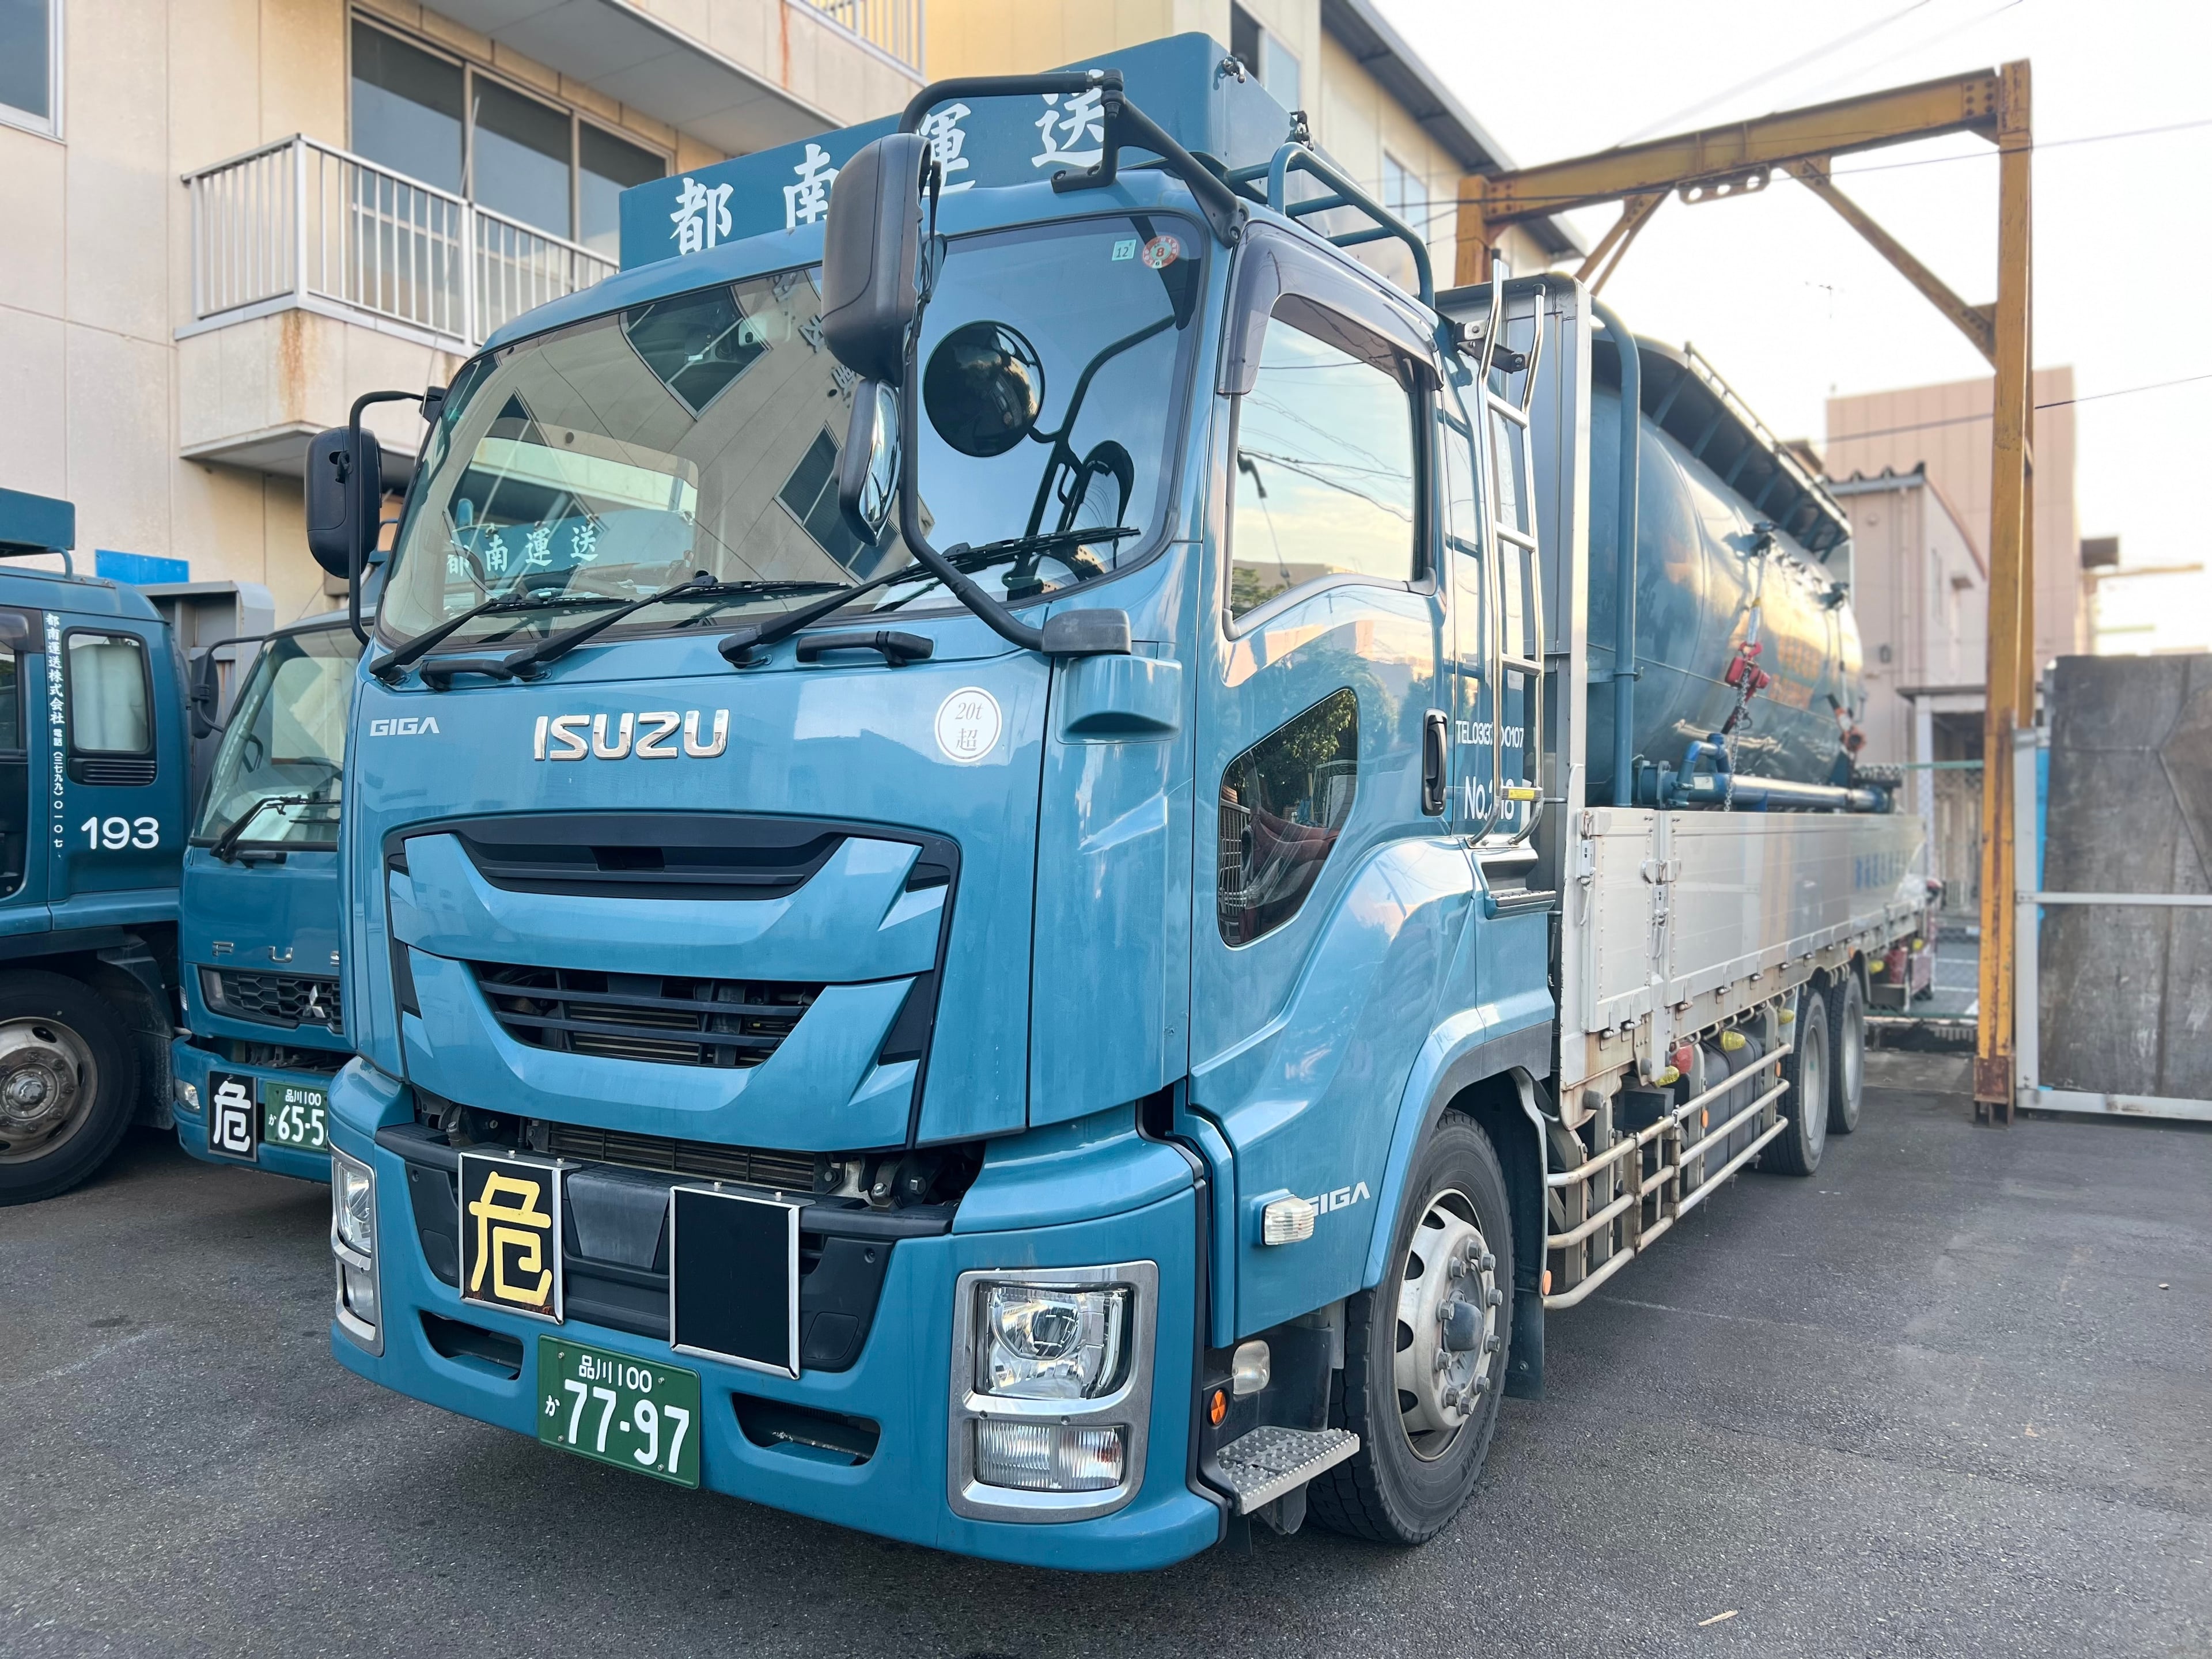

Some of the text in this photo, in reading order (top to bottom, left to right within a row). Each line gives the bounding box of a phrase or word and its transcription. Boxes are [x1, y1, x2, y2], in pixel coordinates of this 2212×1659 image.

[46, 613, 65, 725] 都南運送株式会社
[369, 717, 440, 737] GIGA
[955, 702, 983, 719] 20t
[533, 709, 730, 762] ISUZU
[956, 728, 978, 751] 超
[81, 816, 159, 850] 193
[214, 1081, 251, 1152] 危
[268, 1105, 328, 1146] か 65-5
[468, 1171, 552, 1306] 危
[544, 1378, 690, 1473] か 77-97
